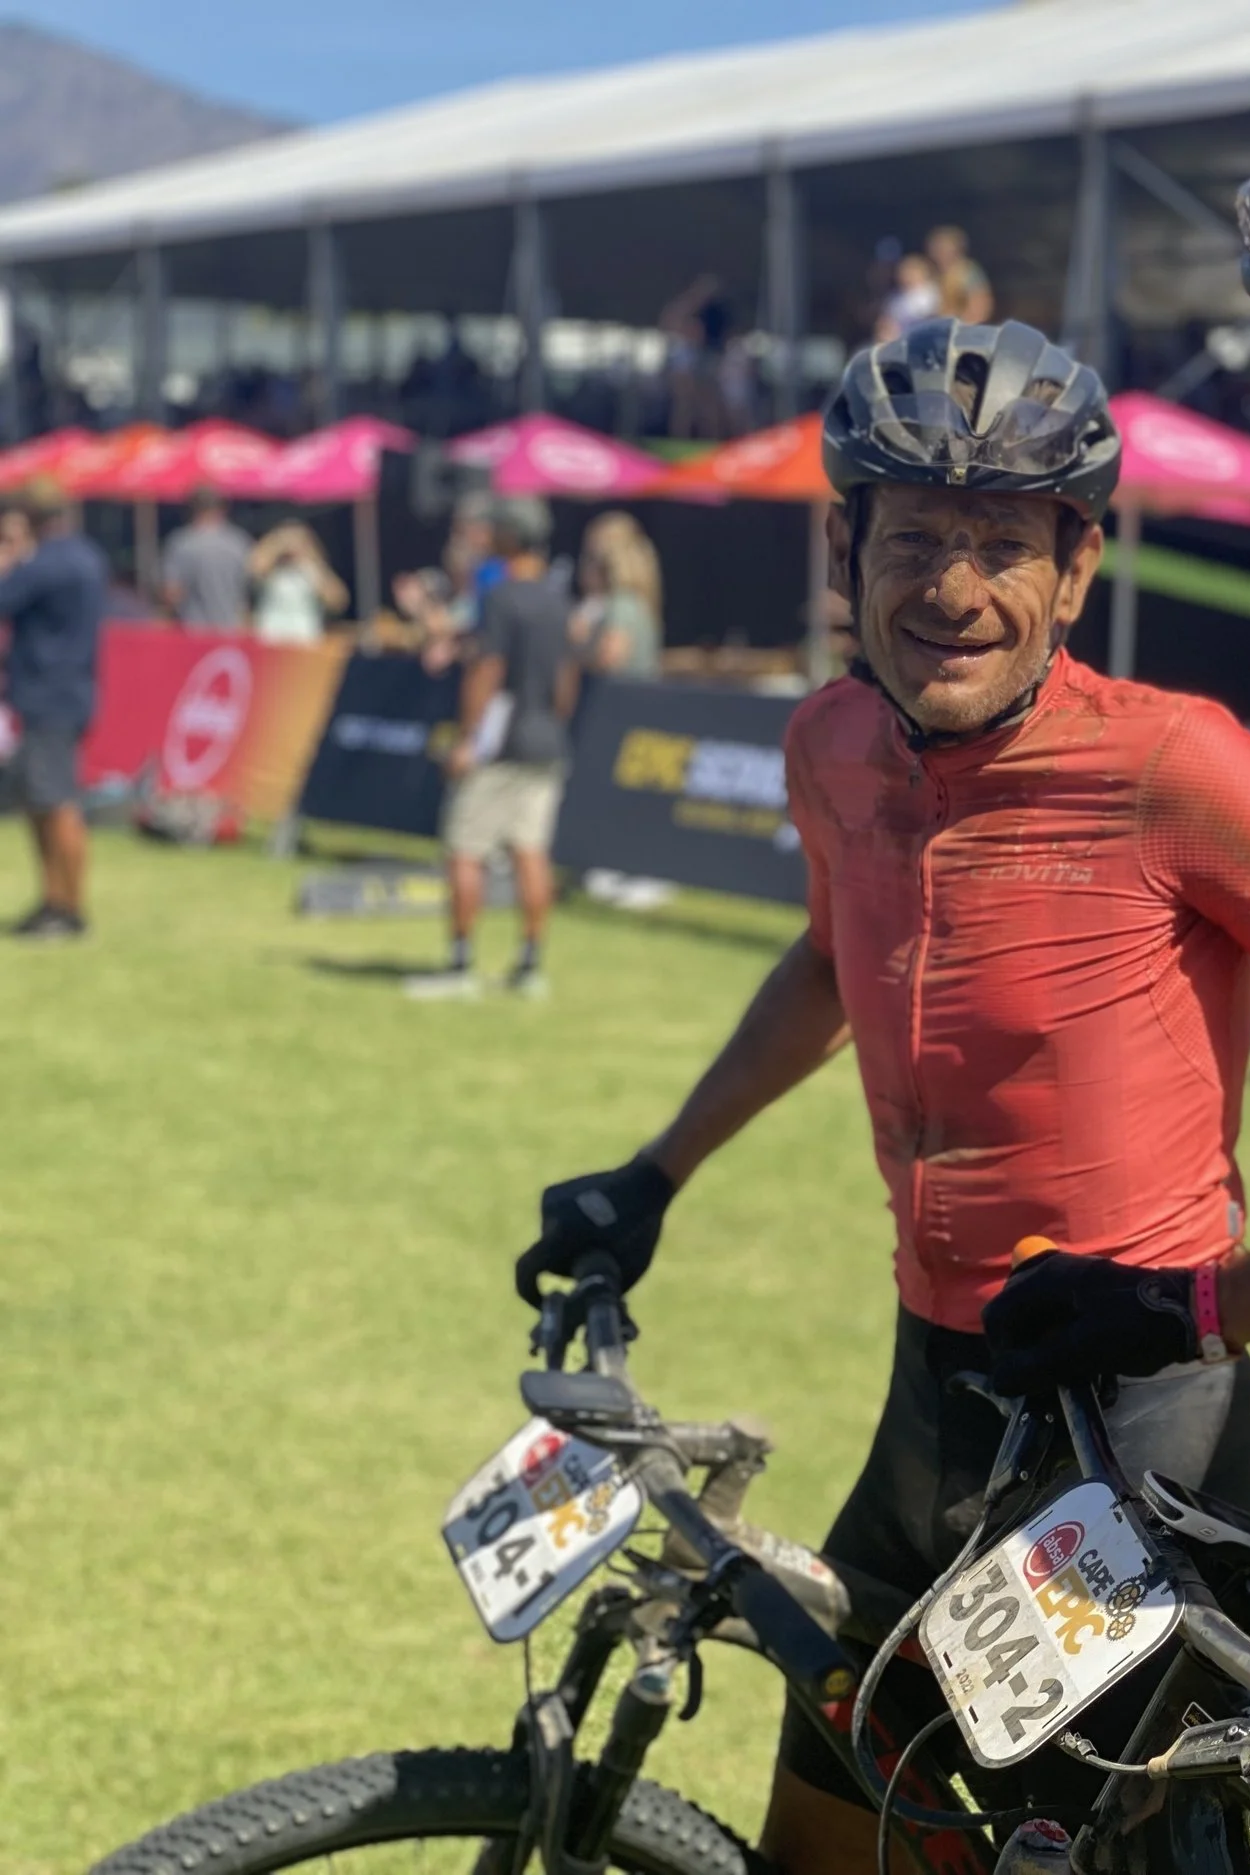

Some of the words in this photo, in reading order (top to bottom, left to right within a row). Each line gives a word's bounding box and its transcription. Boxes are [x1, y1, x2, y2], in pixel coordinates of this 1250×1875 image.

[1040, 1532, 1067, 1568] absa
[1077, 1548, 1116, 1597] CAPE
[1034, 1564, 1106, 1656] EPIC
[948, 1564, 1064, 1745] 304-2
[955, 1668, 974, 1696] 2022
